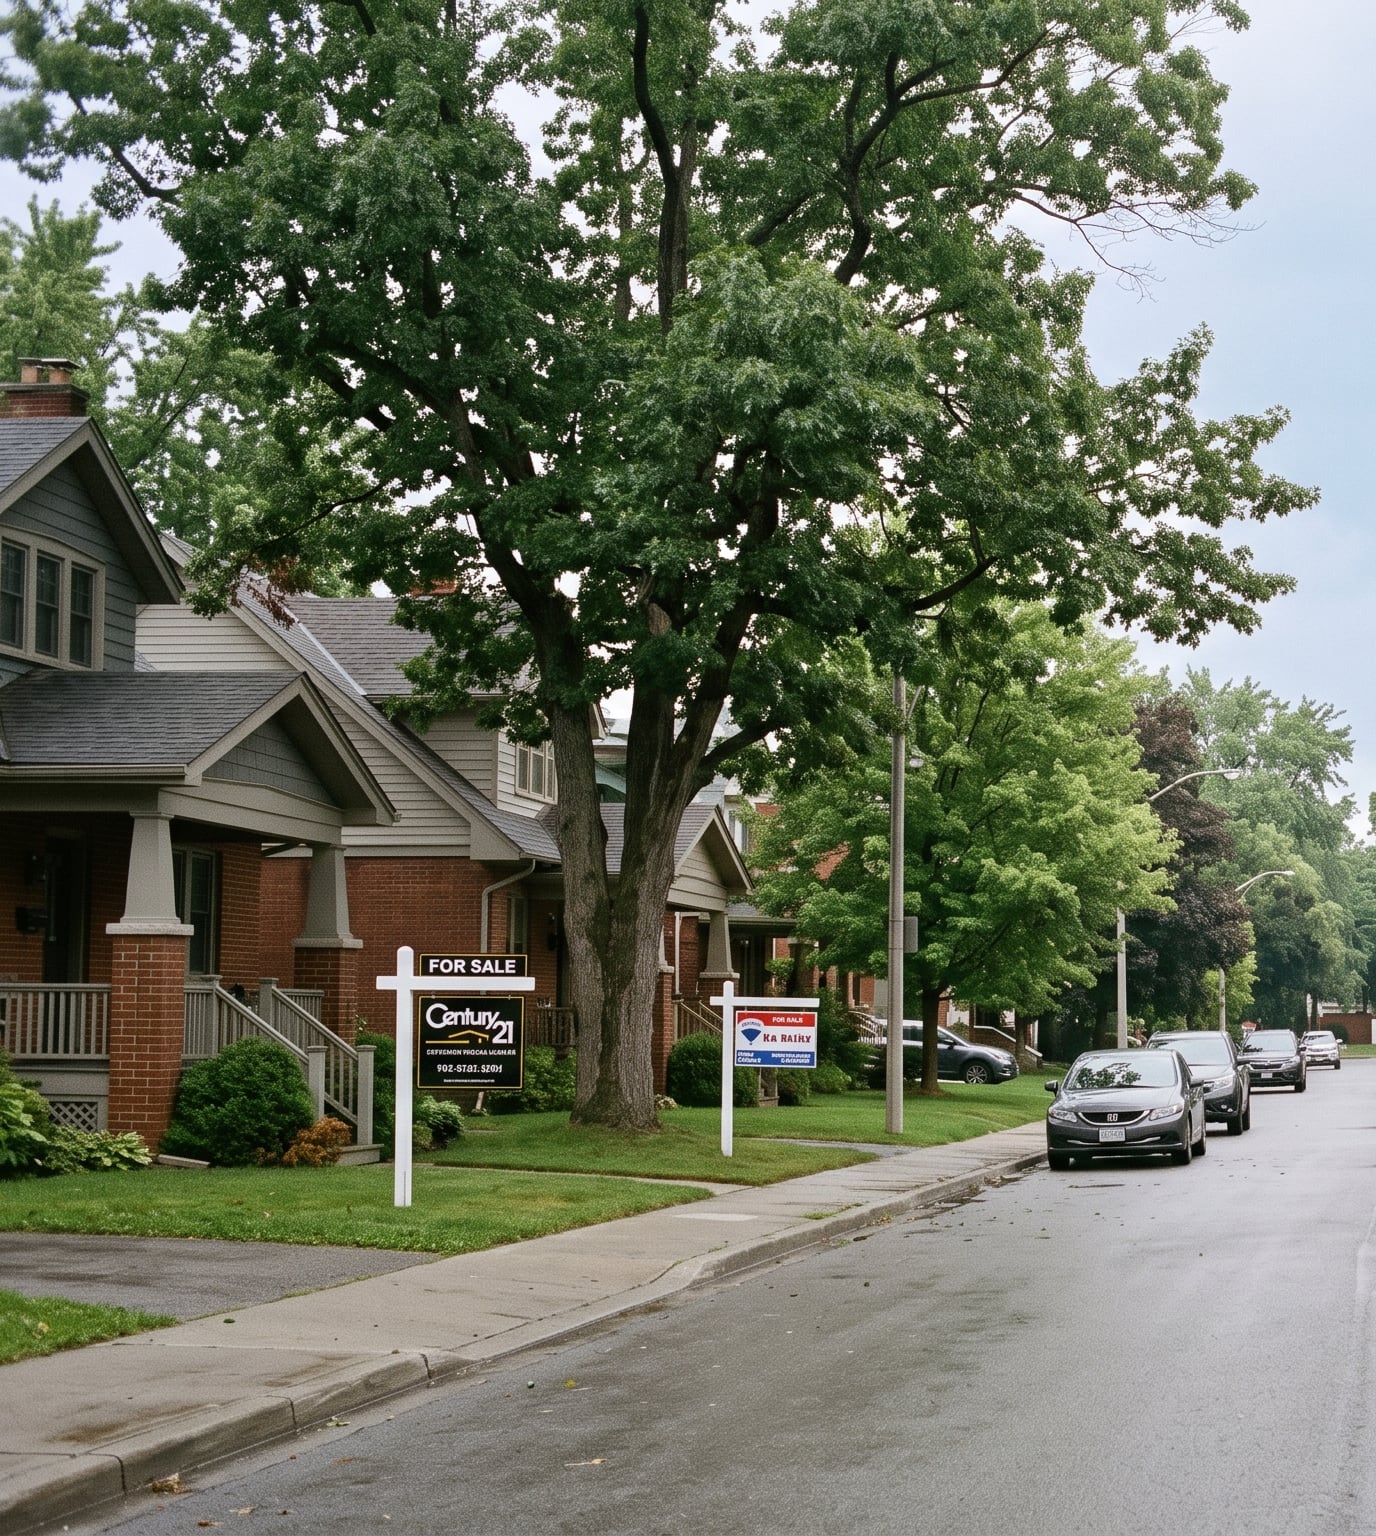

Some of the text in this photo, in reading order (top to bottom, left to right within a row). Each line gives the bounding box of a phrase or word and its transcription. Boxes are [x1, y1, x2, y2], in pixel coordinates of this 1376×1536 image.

[429, 959, 516, 974] FOR SALE
[425, 1002, 514, 1044] Century 21
